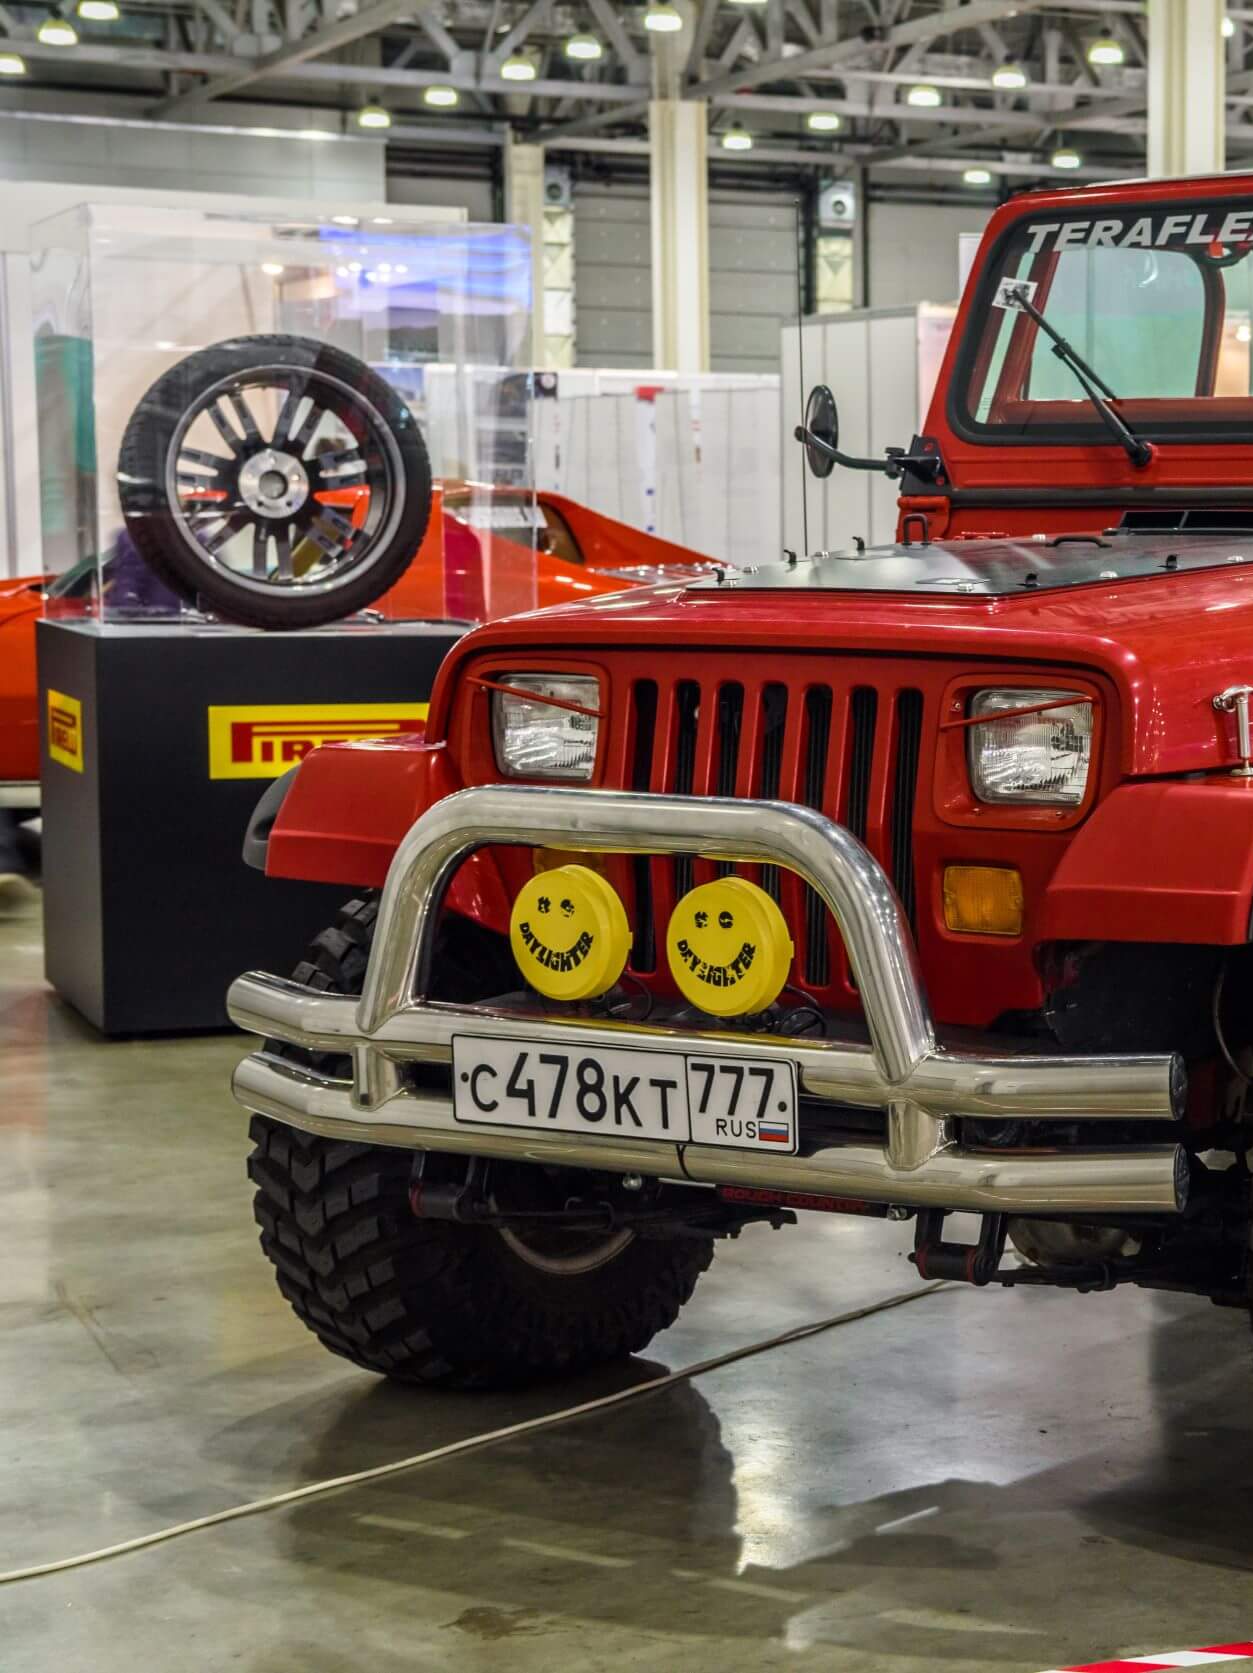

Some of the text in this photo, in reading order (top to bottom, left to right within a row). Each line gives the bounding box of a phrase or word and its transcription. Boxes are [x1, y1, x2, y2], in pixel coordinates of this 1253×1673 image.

[519, 922, 594, 973] DAYLIGHTER
[690, 1062, 775, 1119] 777
[715, 1118, 757, 1139] RUS
